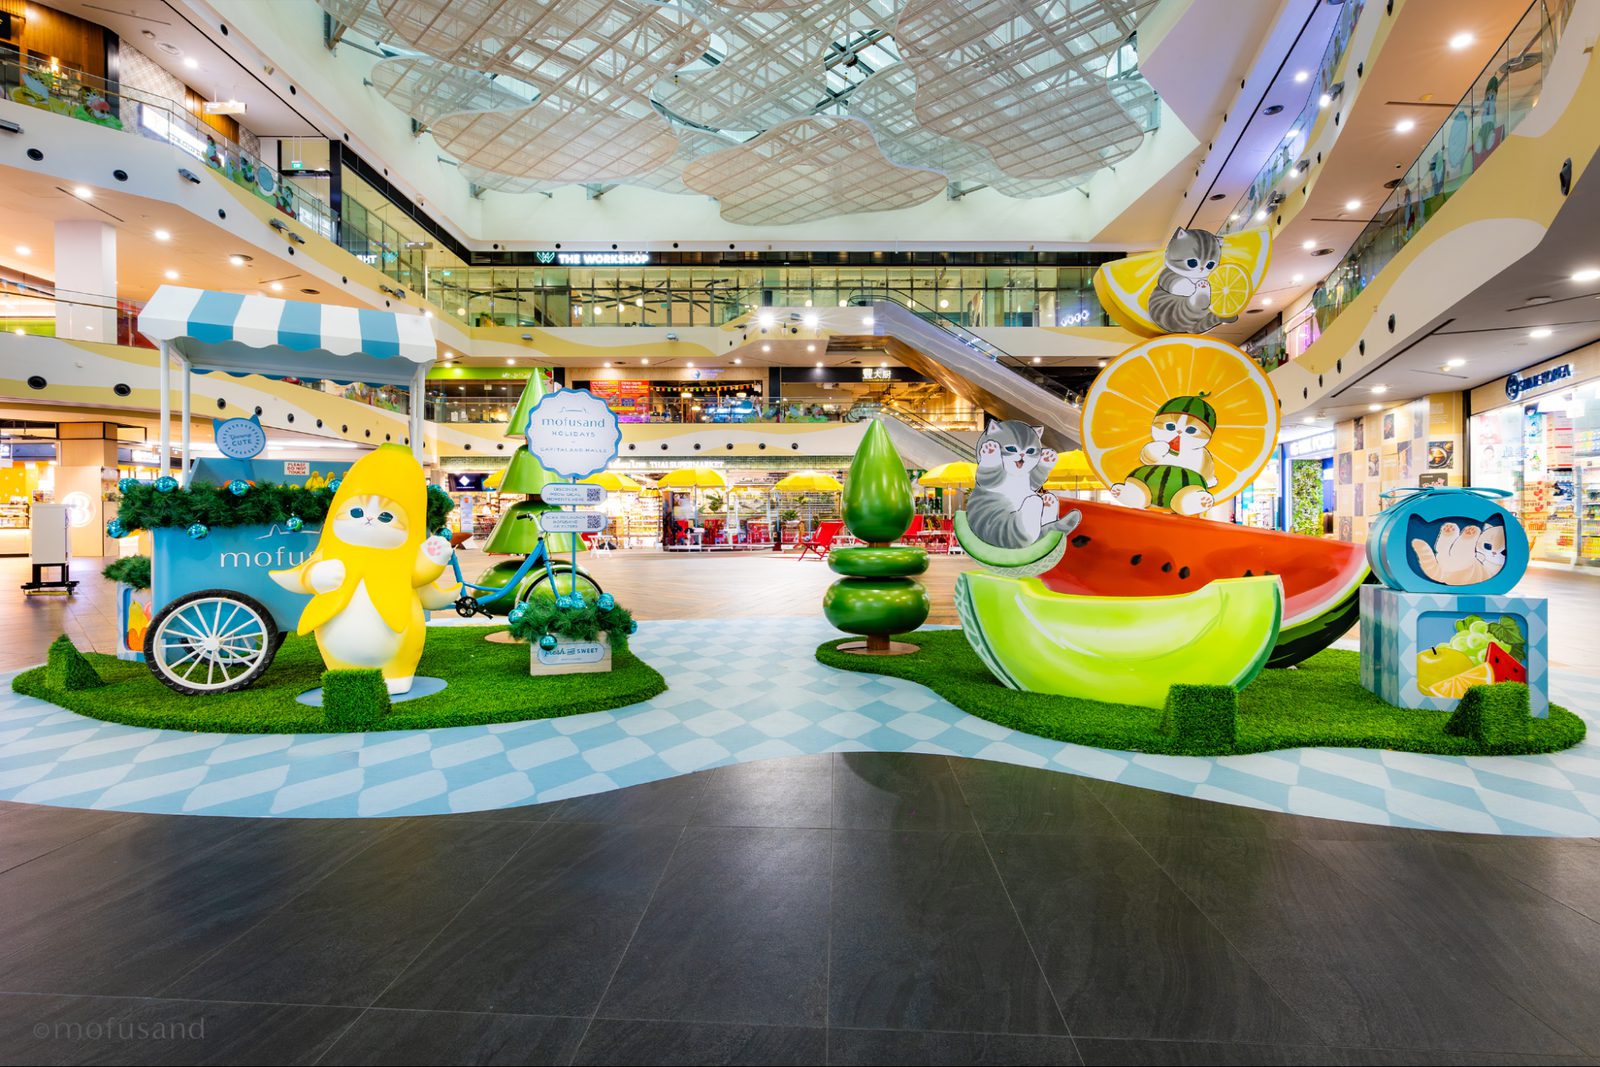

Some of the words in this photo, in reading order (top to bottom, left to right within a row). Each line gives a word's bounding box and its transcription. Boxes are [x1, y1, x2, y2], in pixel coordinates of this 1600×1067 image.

[558, 254, 580, 264] THE
[583, 254, 649, 264] WORKSHOP
[541, 417, 605, 429] mofusand
[231, 439, 253, 447] CUTE
[670, 461, 724, 469] SUPERMARKET
[220, 546, 314, 568] mofu
